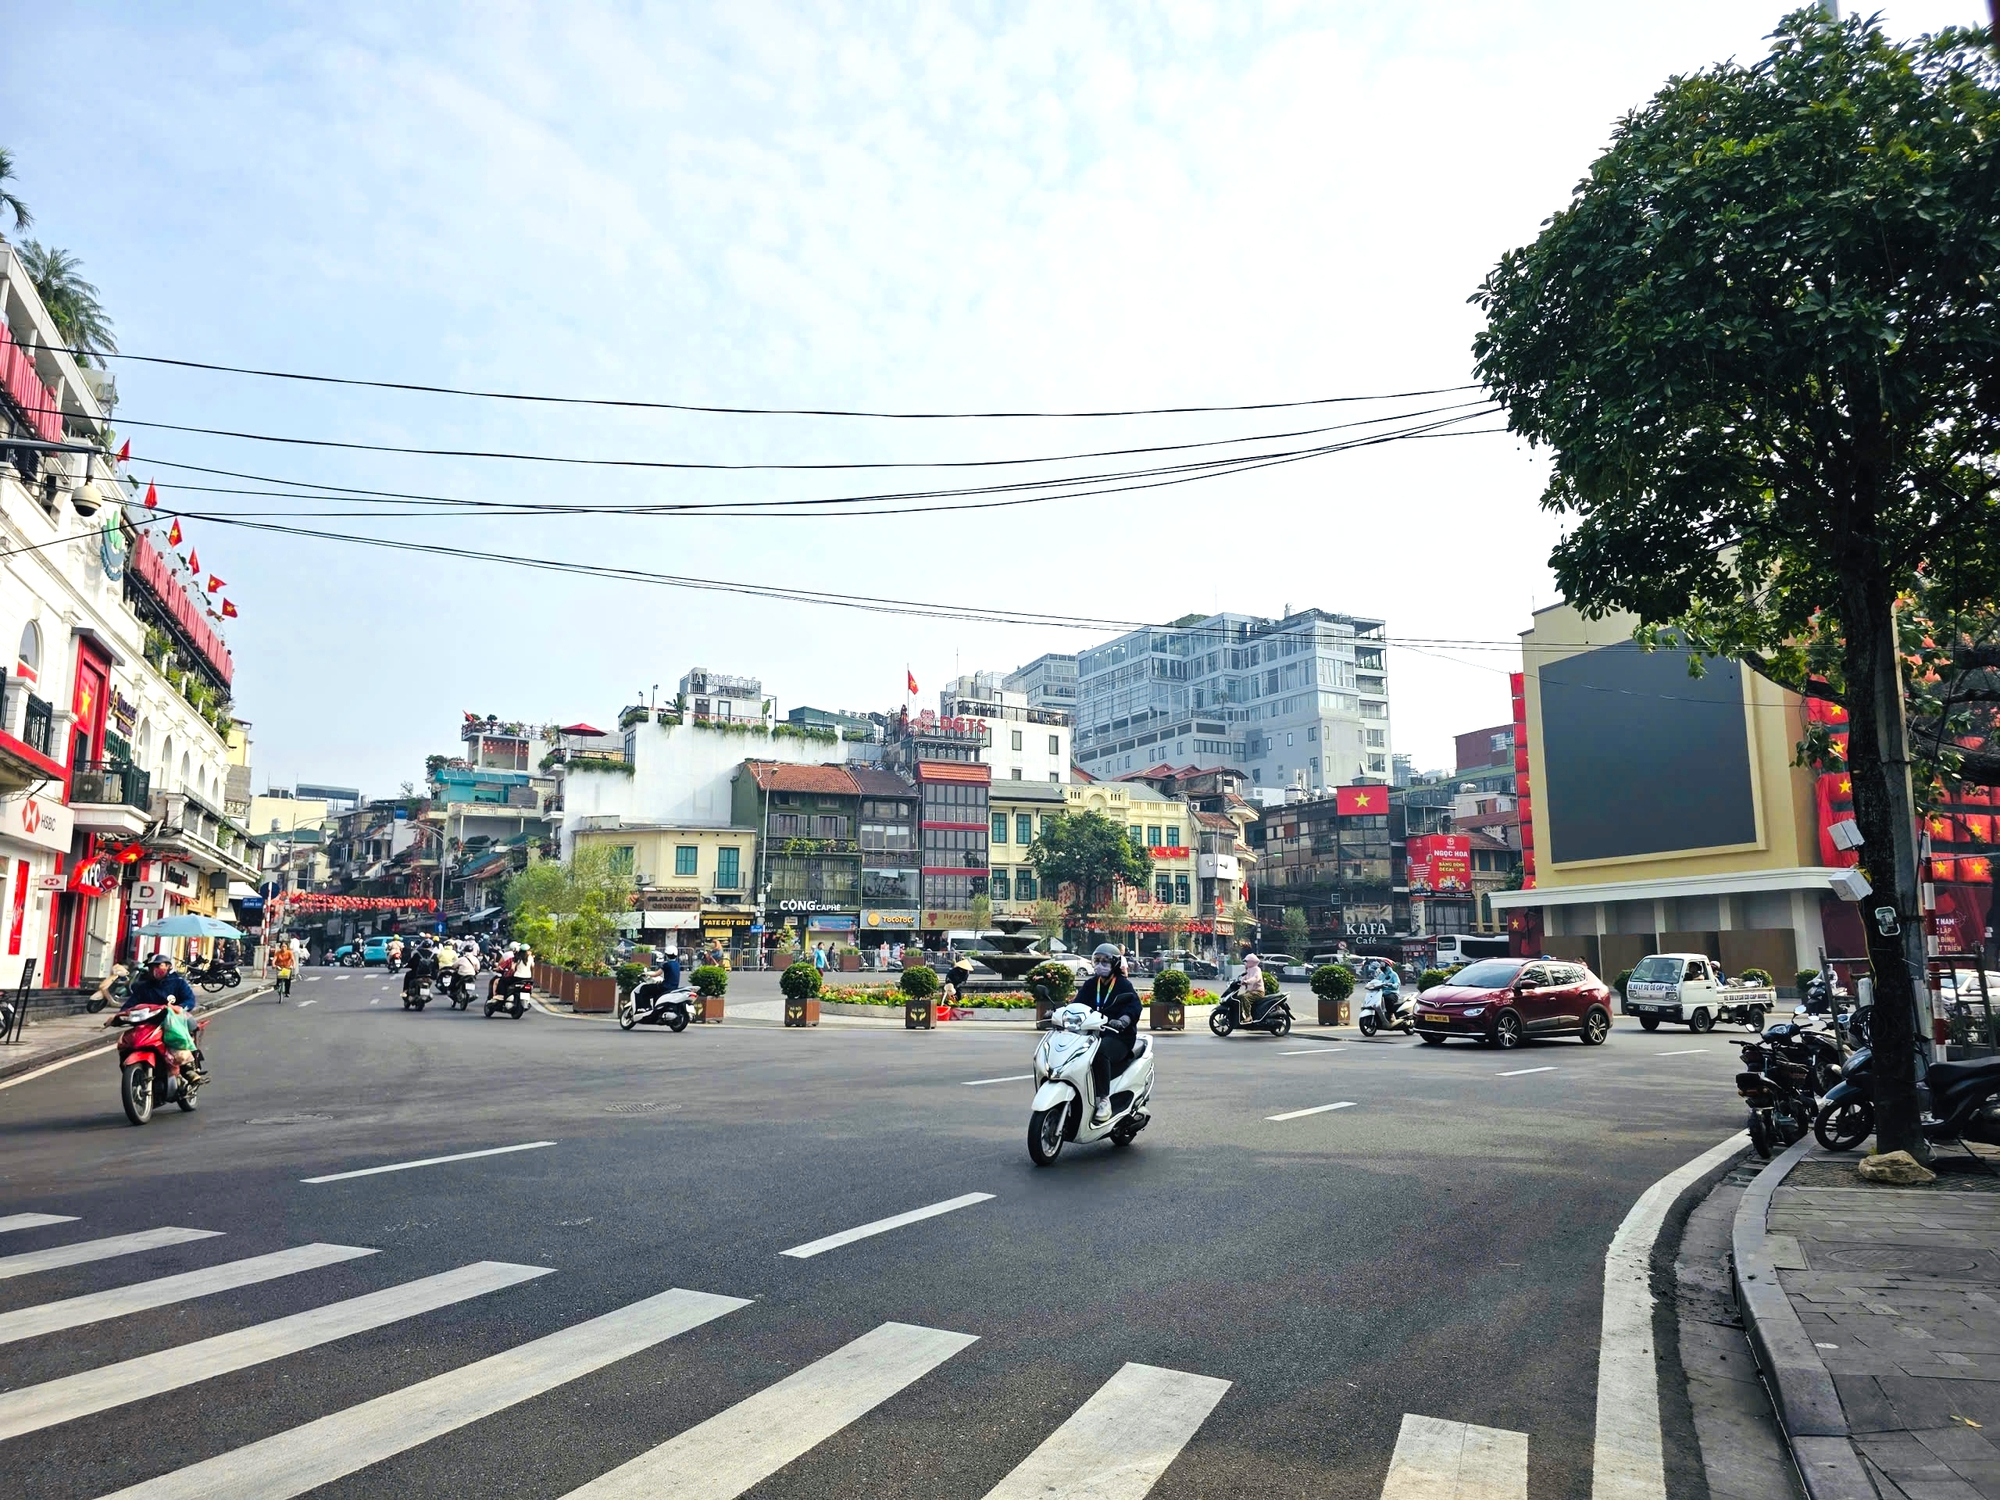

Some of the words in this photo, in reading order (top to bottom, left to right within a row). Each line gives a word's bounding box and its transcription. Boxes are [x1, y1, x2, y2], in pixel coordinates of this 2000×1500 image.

[41, 814, 57, 832] HSBC
[1434, 850, 1453, 858] NGỌC
[780, 898, 816, 912] CỘNG
[721, 919, 735, 927] CỘT
[1345, 923, 1388, 935] KAFA
[1355, 936, 1377, 945] Café
